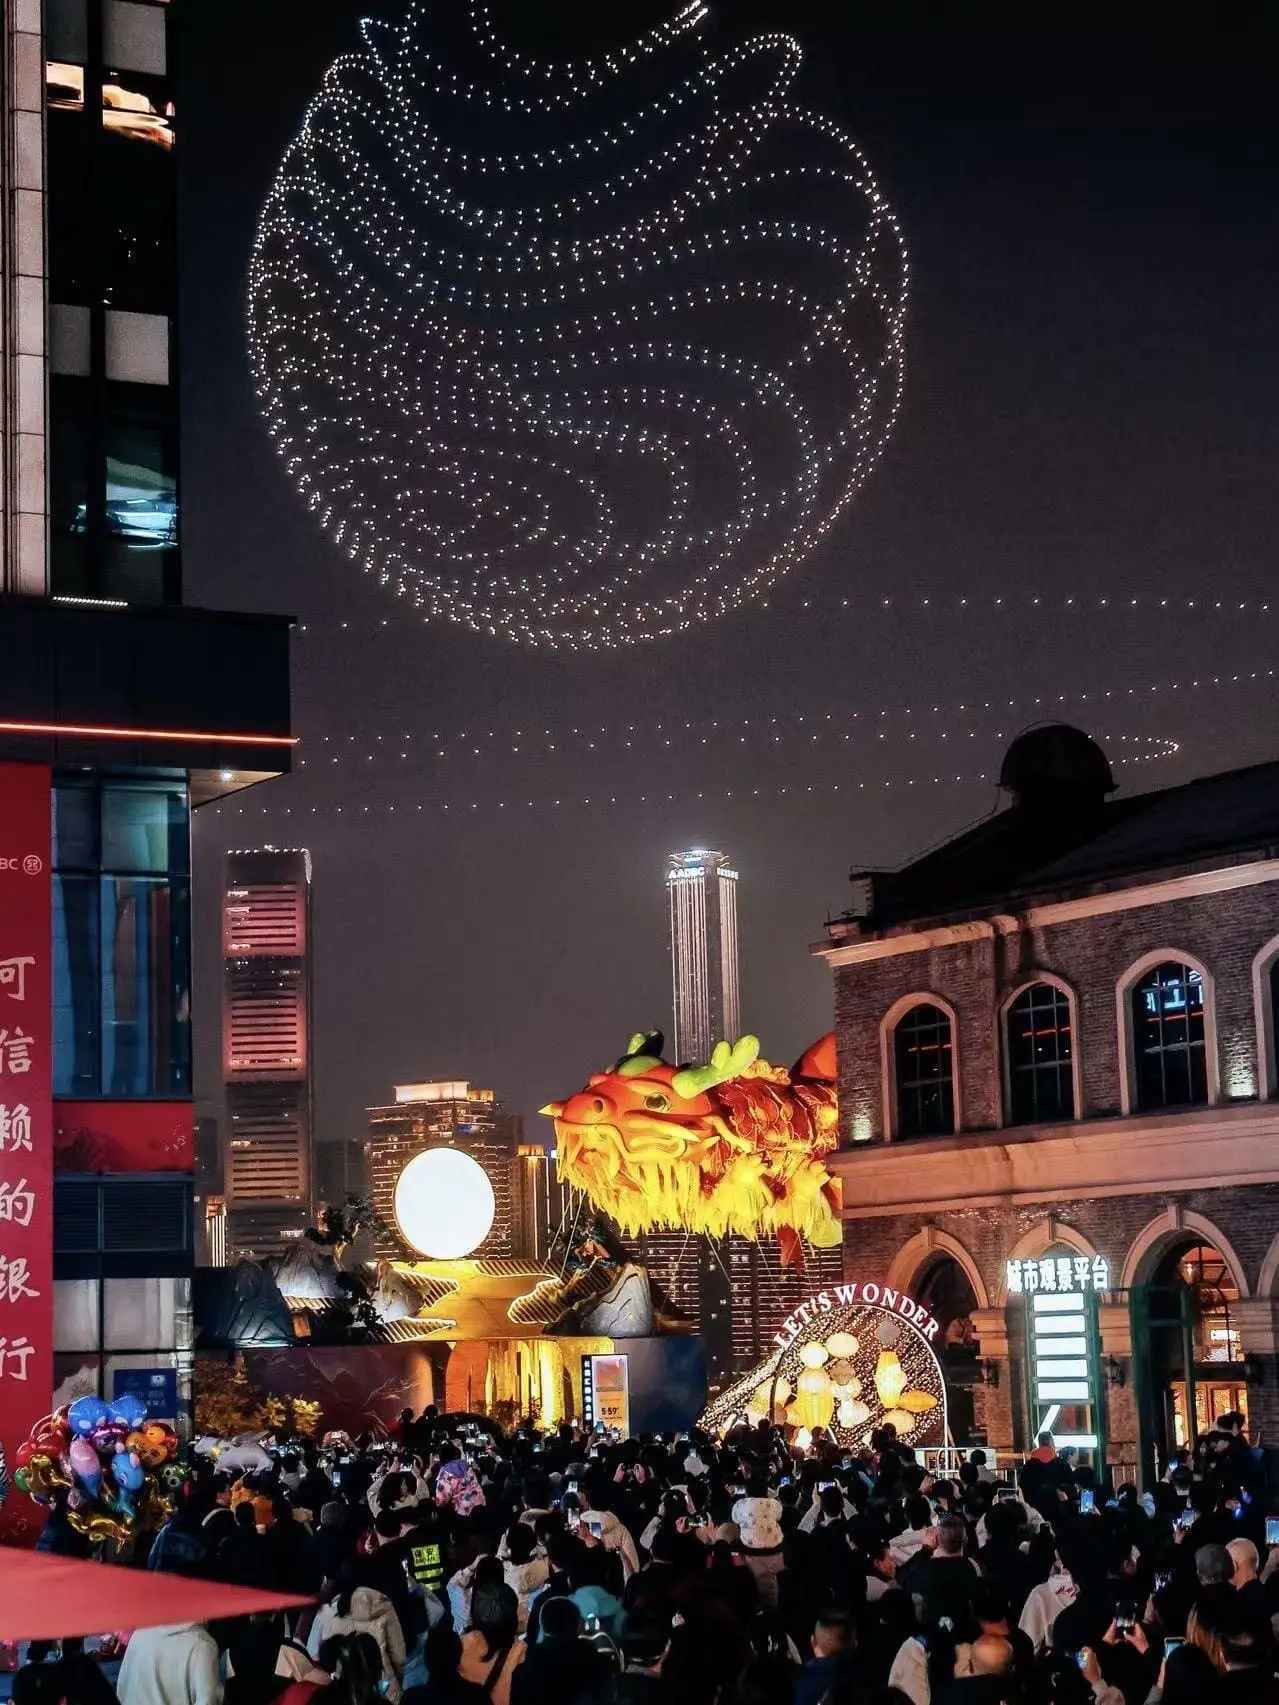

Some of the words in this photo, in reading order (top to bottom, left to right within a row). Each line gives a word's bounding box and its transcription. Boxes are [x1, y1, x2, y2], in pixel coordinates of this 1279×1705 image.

[1006, 1255, 1109, 1293] 城市观景平台
[773, 1291, 832, 1349] LET'S
[833, 1282, 940, 1341] WONDER
